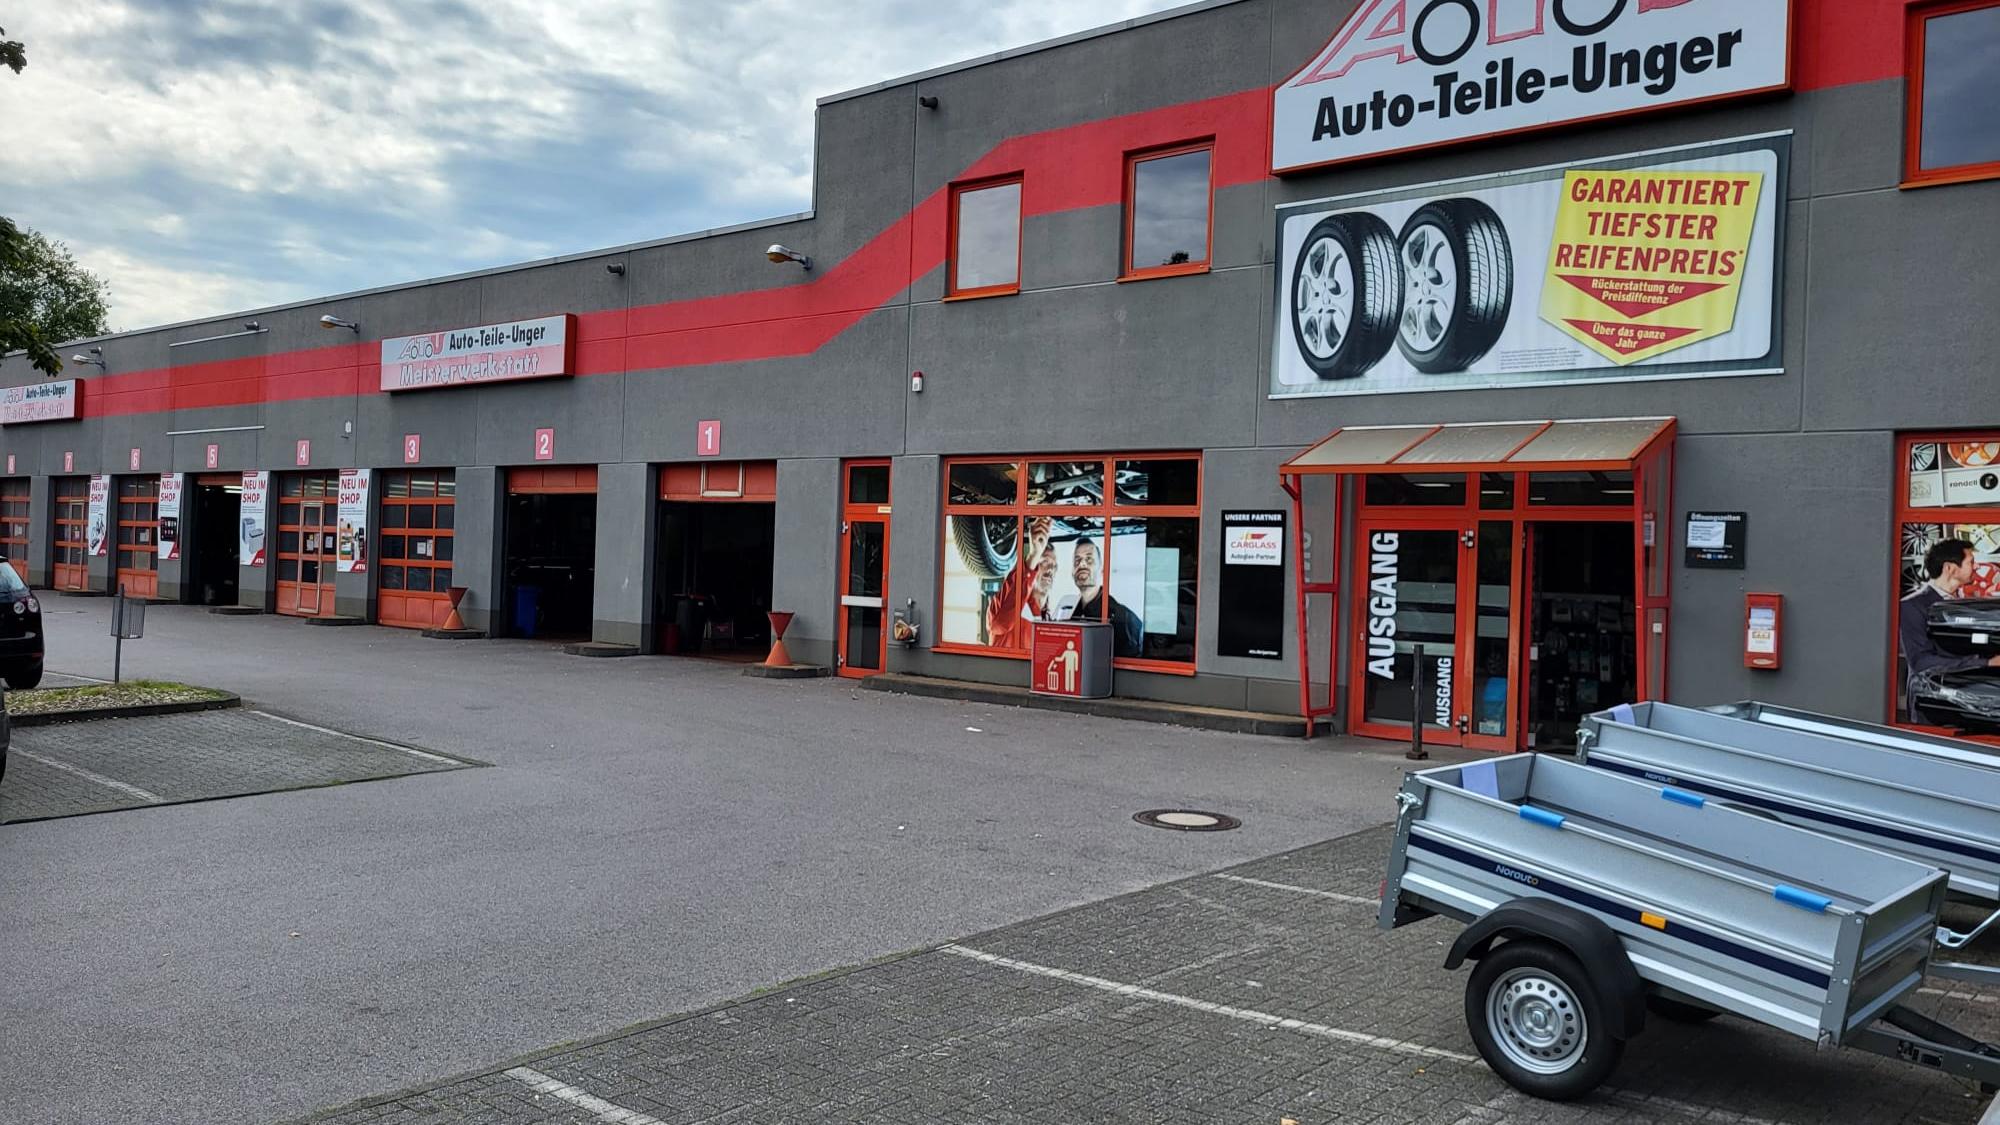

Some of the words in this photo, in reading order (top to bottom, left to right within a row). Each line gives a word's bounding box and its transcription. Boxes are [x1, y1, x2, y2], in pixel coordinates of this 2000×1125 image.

[1312, 29, 1742, 141] Auto-Teile-Unger
[1571, 178, 1749, 206] GARANTIERT
[1588, 212, 1718, 240] TIEFSTER
[1592, 278, 1665, 294] Rückerstattung
[1667, 283, 1685, 294] der
[1602, 290, 1669, 305] Preisdifferenz
[449, 325, 546, 351] Auto-Teile-Unger
[1592, 322, 1616, 336] Über
[1618, 325, 1634, 337] das
[1637, 330, 1666, 341] ganze
[1615, 337, 1639, 349] Jahr
[400, 352, 540, 387] Meisterwerkstatt
[539, 434, 549, 455] 2
[704, 426, 713, 450] 1
[209, 448, 215, 465] 5
[300, 444, 306, 462] 4
[408, 439, 416, 459] 3
[66, 455, 71, 470] 7
[133, 451, 138, 467] 6
[161, 480, 173, 490] NEU
[174, 480, 181, 490] IM
[244, 479, 256, 490] NEU
[258, 479, 266, 490] IM
[341, 478, 356, 489] NEU
[358, 478, 367, 489] IM
[1224, 513, 1250, 521] UNSERE
[1251, 513, 1282, 522] PARTNER
[1368, 532, 1399, 680] AUSGANG
[1436, 657, 1451, 728] AUSGANG
[1495, 864, 1539, 885] Norauto
